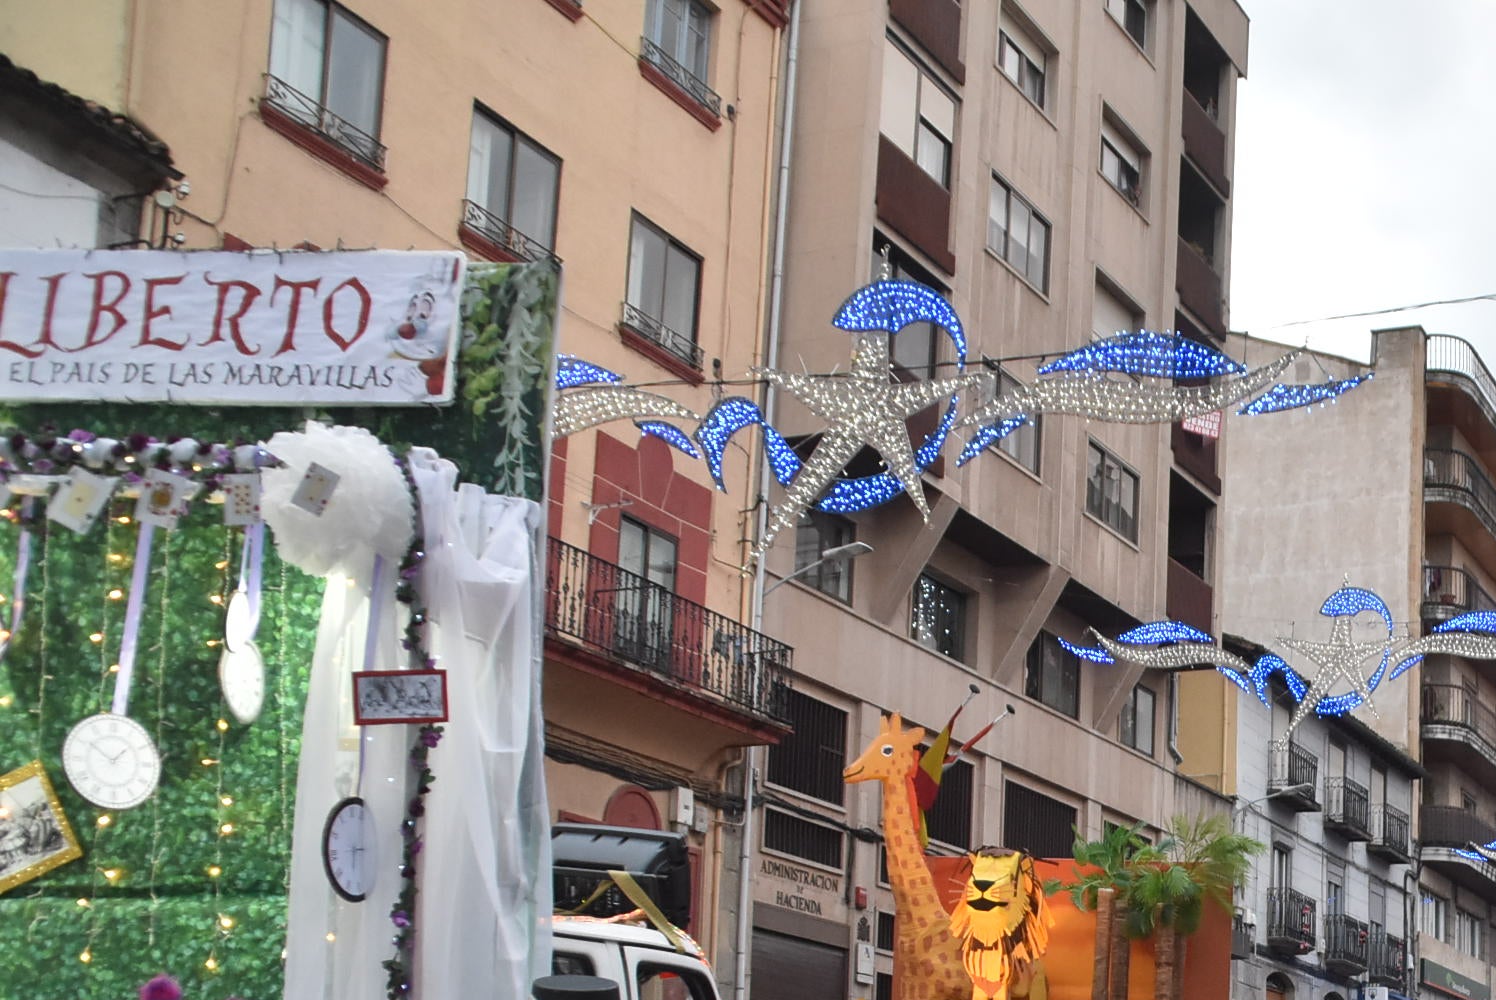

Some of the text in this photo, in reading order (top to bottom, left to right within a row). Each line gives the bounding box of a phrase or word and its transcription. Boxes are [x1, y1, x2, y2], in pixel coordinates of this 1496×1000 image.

[8, 361, 396, 390] EL PAIS DE LAS MARAVILLAS
[760, 860, 839, 892] ADMINISTRACION
[776, 890, 822, 916] HACIENDA
